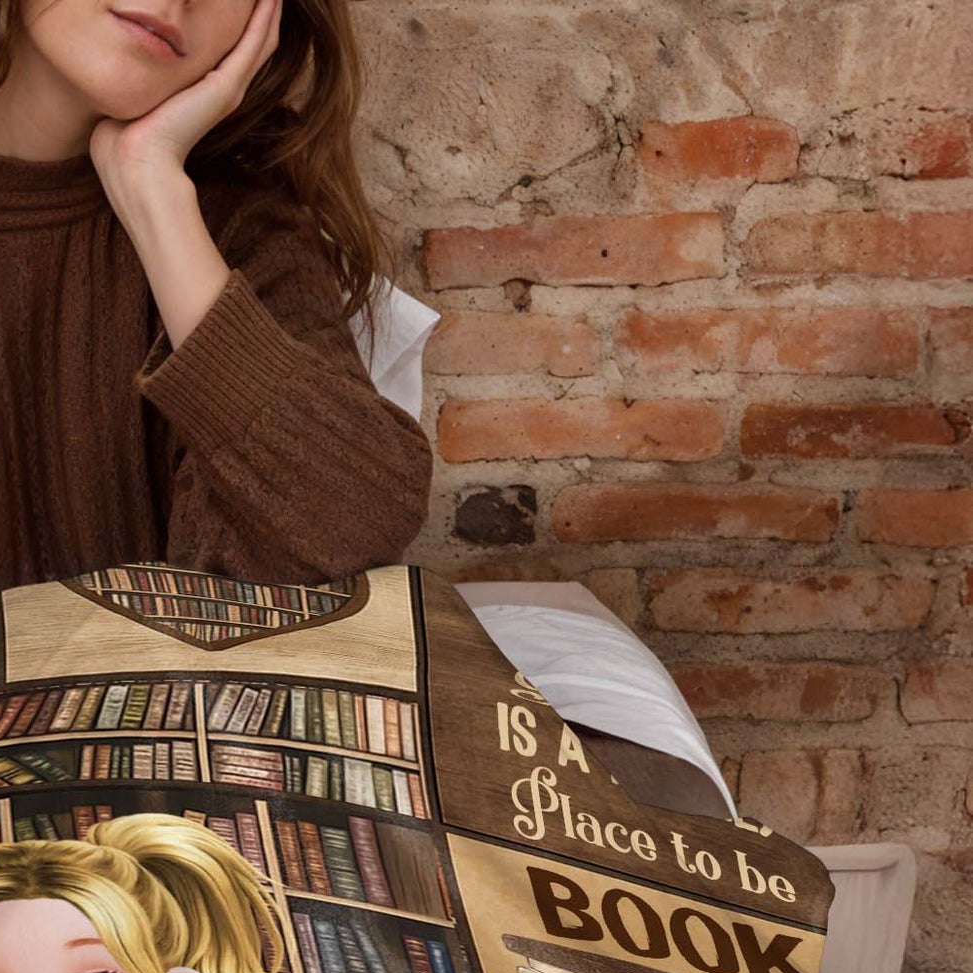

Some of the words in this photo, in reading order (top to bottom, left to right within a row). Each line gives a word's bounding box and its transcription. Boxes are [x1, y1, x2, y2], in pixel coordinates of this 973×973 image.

[497, 702, 538, 757] IS
[558, 722, 590, 774] A
[511, 766, 657, 861] Place
[670, 831, 722, 880] to
[733, 849, 796, 903] be
